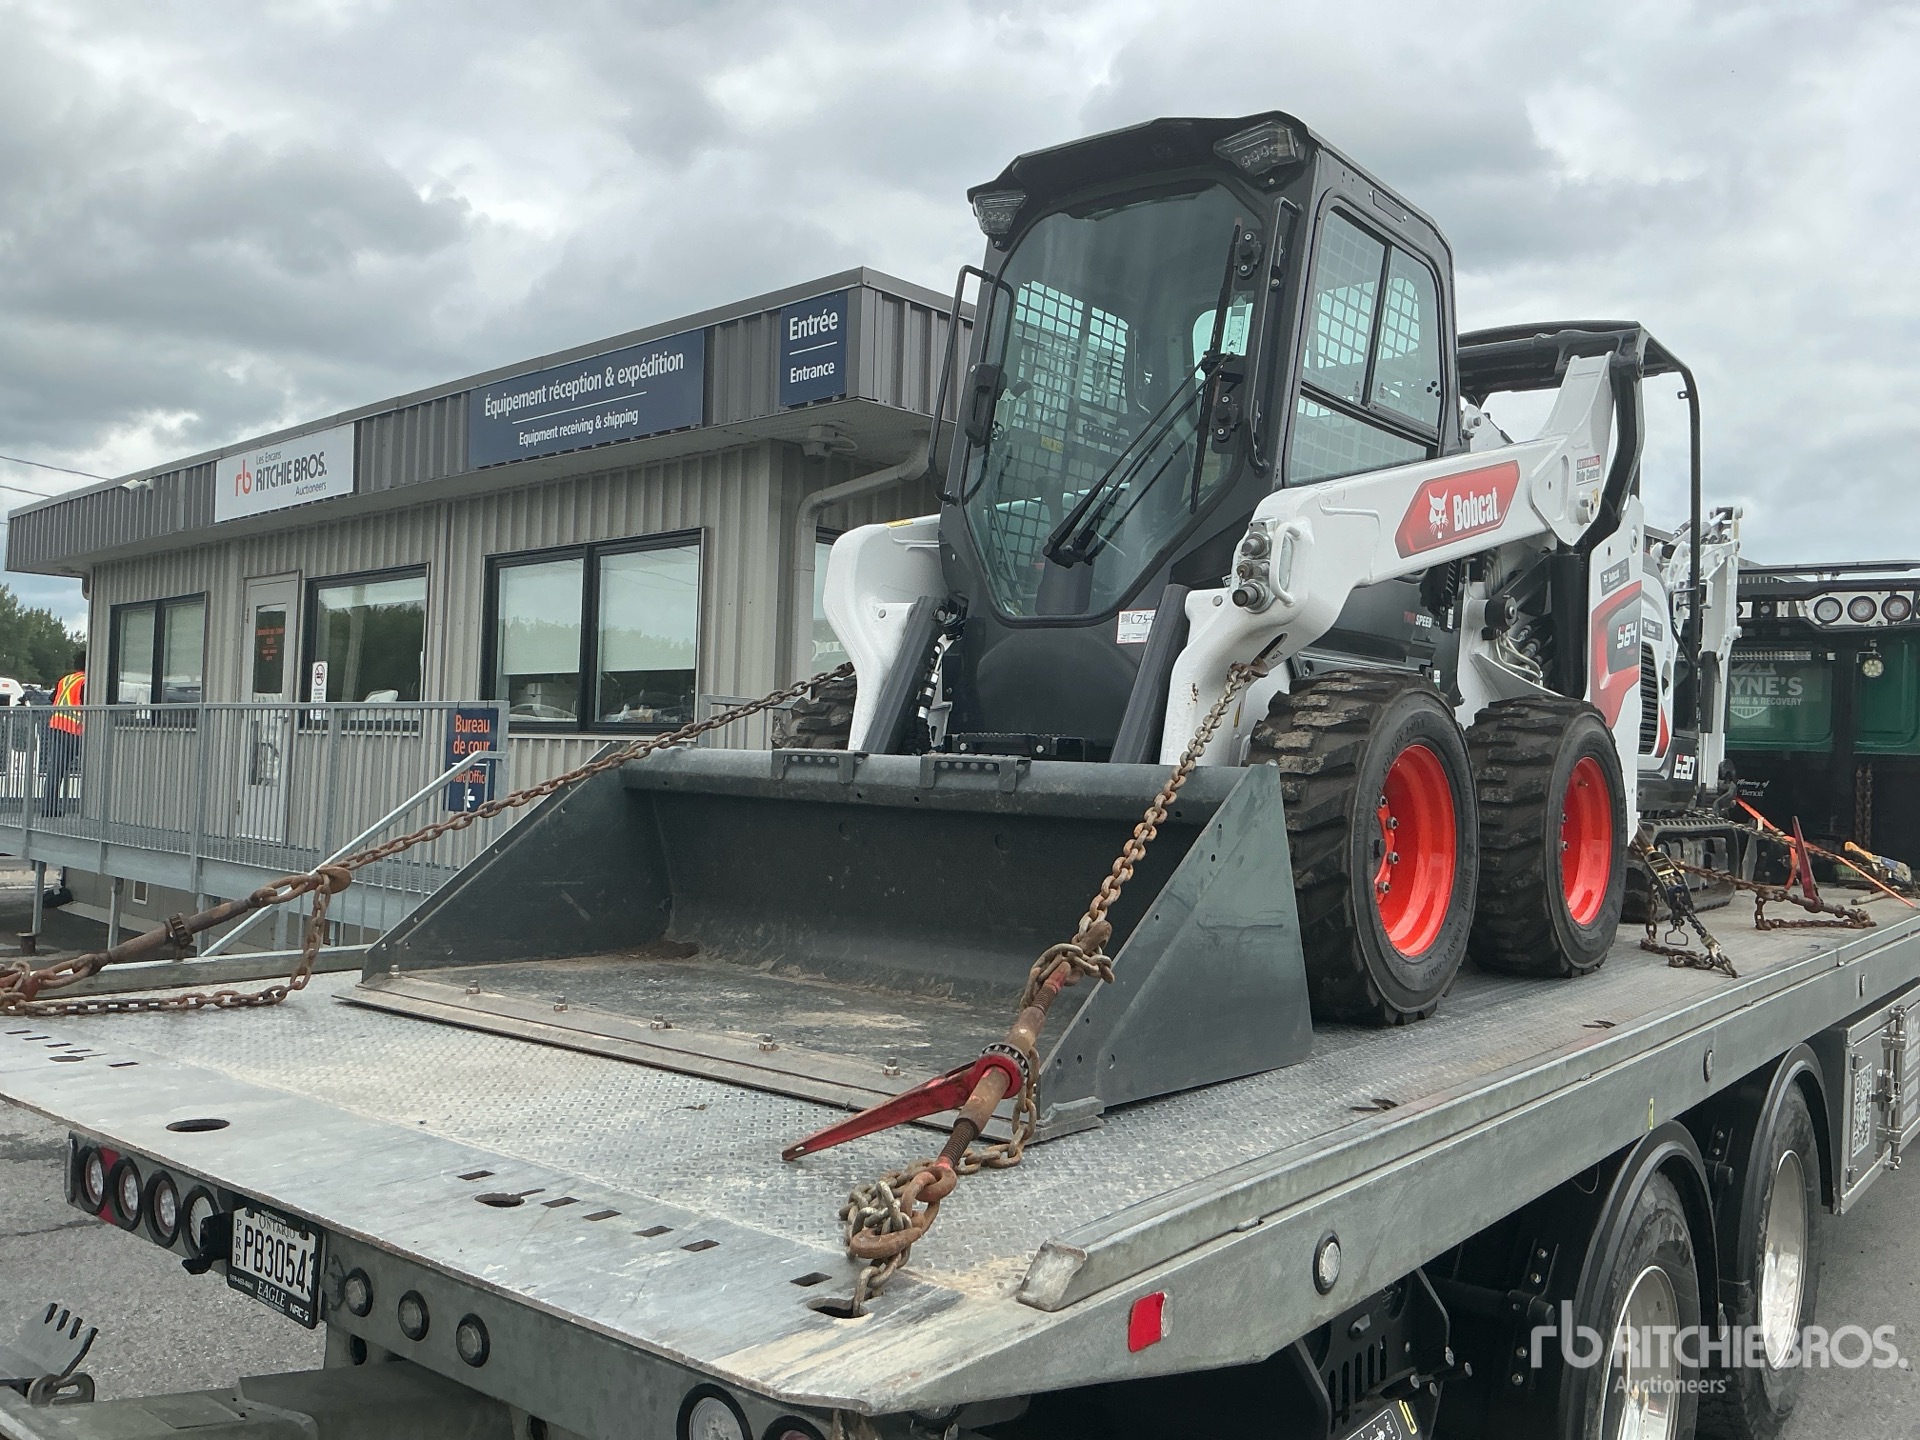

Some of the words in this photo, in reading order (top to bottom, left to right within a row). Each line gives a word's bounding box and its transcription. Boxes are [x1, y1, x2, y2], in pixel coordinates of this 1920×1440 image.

[789, 308, 839, 341] Entrée
[789, 361, 836, 384] Entrance
[484, 384, 548, 420] Équipement
[548, 370, 602, 402] réception
[604, 366, 615, 388] &
[617, 351, 685, 388] expédition
[518, 424, 558, 448] Equipment
[559, 417, 594, 436] receiving
[594, 414, 602, 430] &
[603, 407, 639, 427] shipping
[255, 459, 292, 492] RITCHIE
[293, 450, 328, 483] BROS.
[294, 481, 327, 497] Auctioneers
[1452, 486, 1499, 532] Bobcat
[1415, 614, 1433, 628] SPEED
[1616, 621, 1638, 649] S64
[1730, 676, 1803, 696] YNE'S
[1760, 697, 1802, 706] RECOVERY
[455, 714, 490, 733] Bureau
[453, 735, 466, 755] de
[468, 741, 490, 756] cour
[1673, 753, 1696, 780] E20
[258, 1215, 296, 1239] ONTARIO
[257, 1280, 287, 1308] EAGLE
